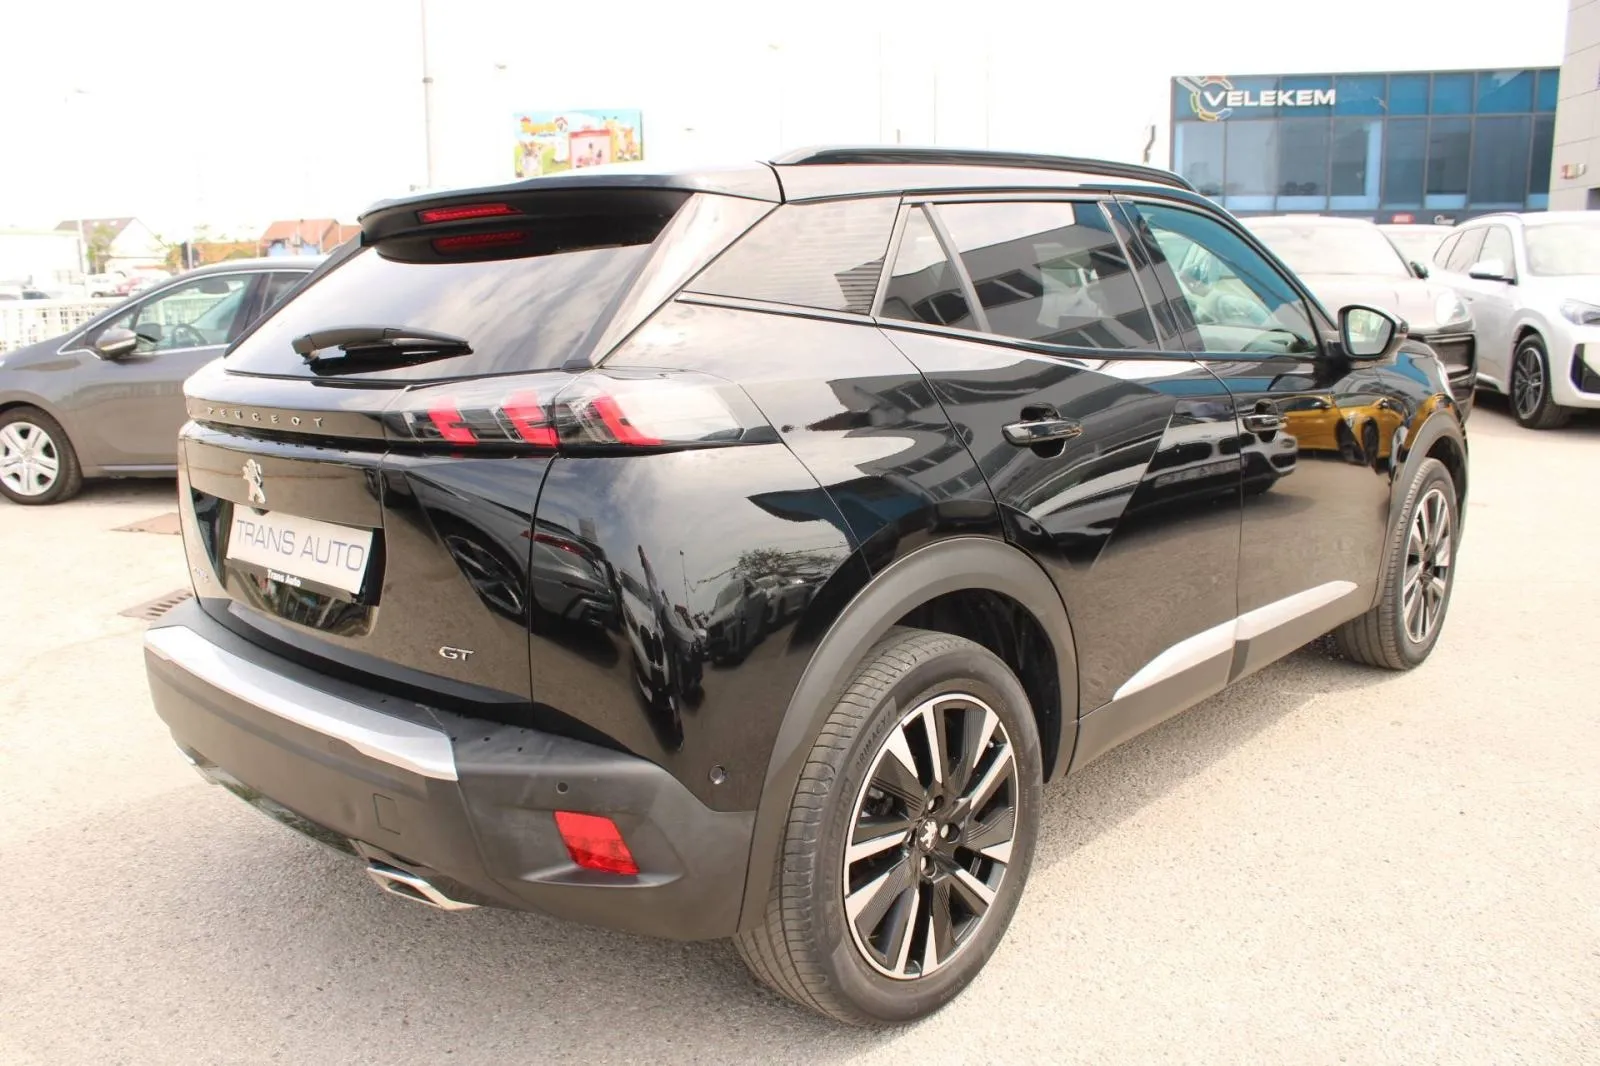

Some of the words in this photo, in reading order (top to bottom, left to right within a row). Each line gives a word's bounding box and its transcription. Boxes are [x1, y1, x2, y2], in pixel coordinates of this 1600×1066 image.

[1203, 89, 1336, 107] VELEKEM
[207, 406, 323, 429] PEUGEOT
[236, 519, 296, 556] TRANS
[300, 535, 365, 572] AUTO
[439, 646, 475, 661] GT
